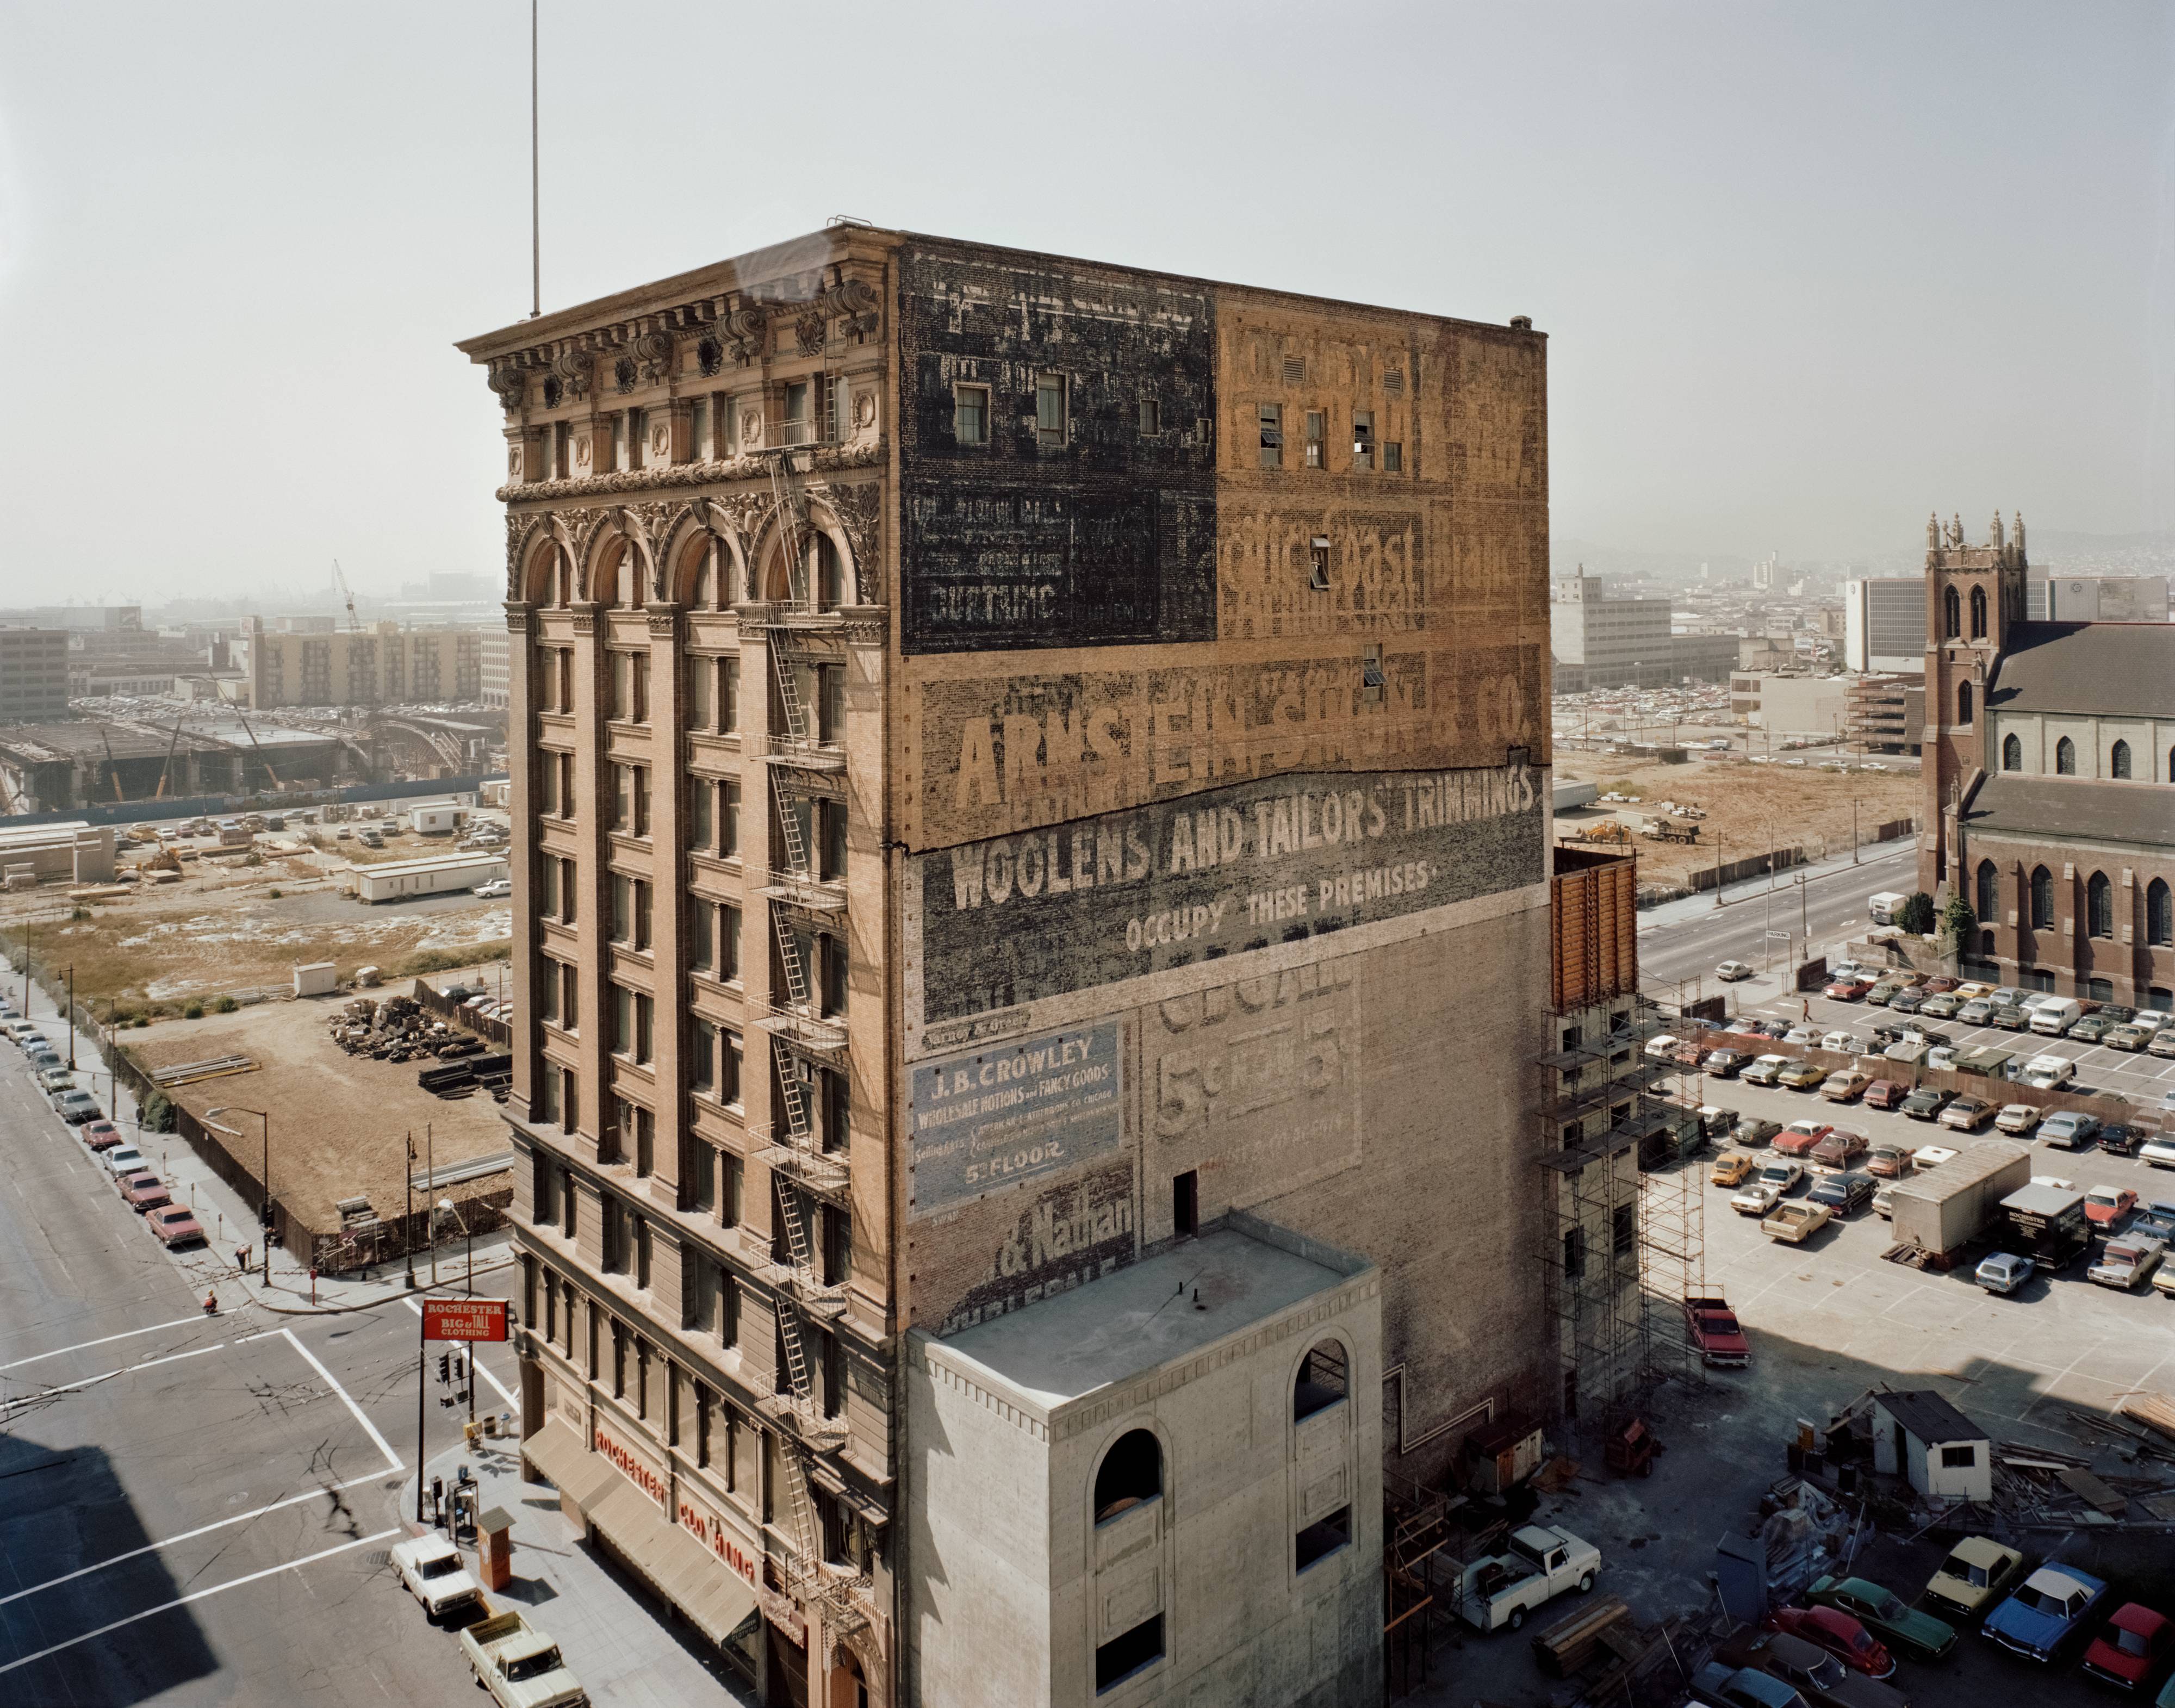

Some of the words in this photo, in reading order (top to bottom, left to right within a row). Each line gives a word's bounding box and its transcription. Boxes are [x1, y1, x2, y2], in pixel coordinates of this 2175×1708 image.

[951, 819, 1150, 910] WOOLENS
[1171, 806, 1242, 873] AND
[1402, 765, 1533, 831] TRIMMINGS
[1126, 900, 1227, 952] OCCUPY
[1247, 884, 1308, 926] THESE
[931, 1075, 950, 1100] J.
[954, 1070, 977, 1095] B.
[979, 1037, 1093, 1086] CROWLEY
[918, 1098, 979, 1130] WHOLESALE
[980, 1086, 1024, 1113] NOTIONS
[1026, 1090, 1037, 1099] and
[1039, 1073, 1071, 1097] FANCY
[1072, 1063, 1110, 1087] GOODS
[1084, 1090, 1112, 1104] CHICAGO
[990, 1140, 1065, 1176] FLOOR
[1032, 1190, 1134, 1269] Nathan
[2009, 1211, 2046, 1225] ROCHESTER
[427, 1304, 501, 1315] ROCHESTER
[442, 1318, 463, 1328] BIG
[472, 1314, 490, 1329] TALL
[441, 1328, 489, 1337] CLOTHING
